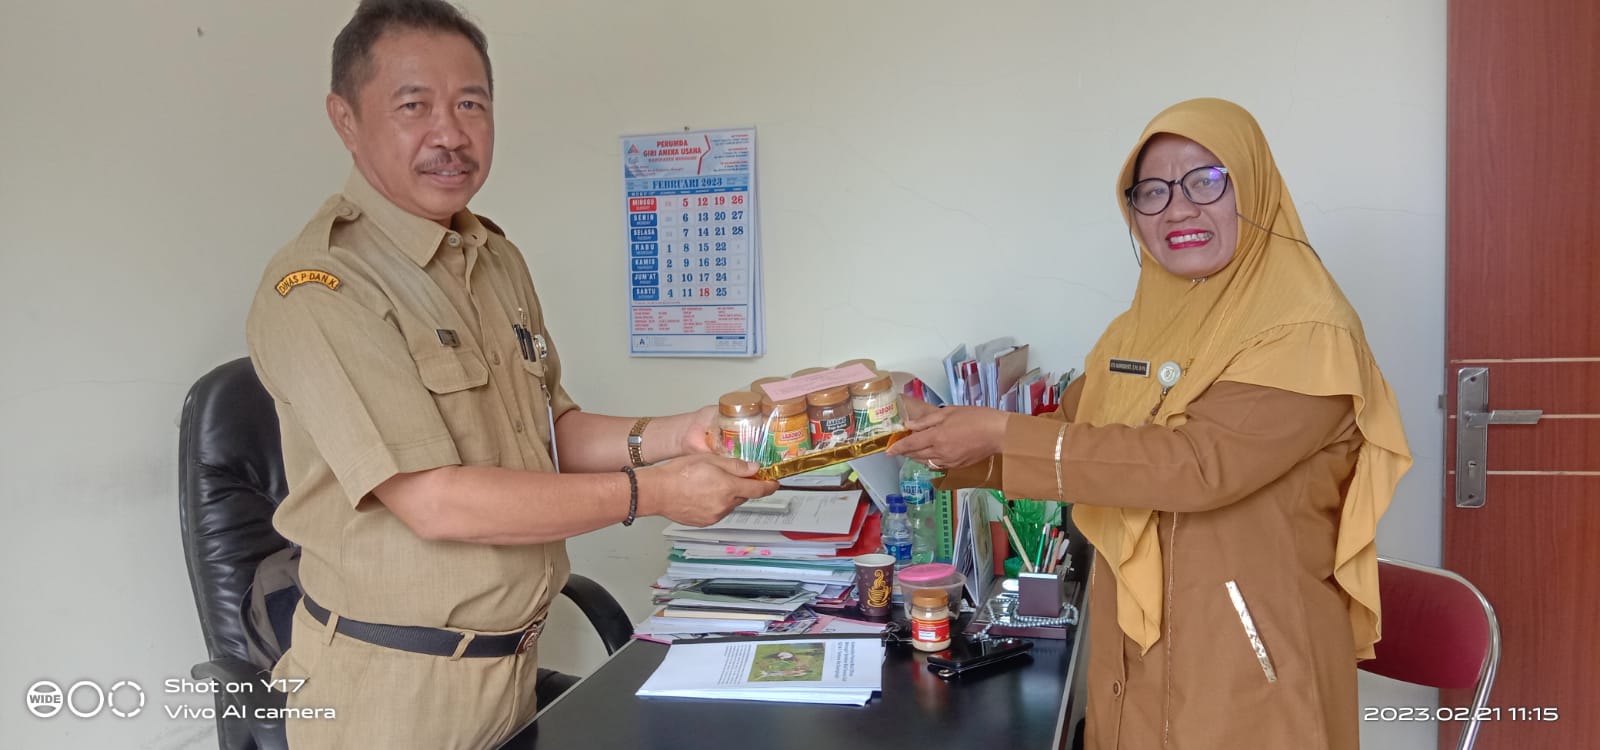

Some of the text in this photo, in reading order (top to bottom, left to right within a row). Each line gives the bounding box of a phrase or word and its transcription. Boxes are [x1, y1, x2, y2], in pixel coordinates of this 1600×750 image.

[656, 139, 688, 148] PERUMDA
[643, 149, 657, 157] GIRI
[652, 178, 699, 190] FEBRUARI
[701, 177, 723, 187] 2023
[682, 198, 689, 207] 5
[697, 197, 708, 207] 12
[714, 196, 725, 205] 19
[731, 195, 744, 205] 26
[682, 213, 689, 222] 6
[698, 212, 709, 222] 13
[714, 211, 726, 221] 20
[731, 210, 744, 220] 27
[683, 228, 689, 237] 7
[698, 228, 709, 237] 14
[714, 226, 725, 236] 21
[731, 225, 744, 235] 28
[667, 244, 672, 253] 1
[683, 243, 690, 252] 8
[698, 242, 710, 252] 15
[715, 241, 727, 251] 22
[666, 259, 673, 268] 2
[683, 258, 690, 268] 9
[699, 257, 710, 267] 16
[715, 256, 727, 267] 23
[279, 272, 337, 293] DINAS P DAN K
[666, 273, 673, 283] 3
[682, 273, 693, 282] 10
[700, 272, 710, 282] 17
[715, 272, 727, 282] 24
[667, 288, 674, 298] 4
[682, 288, 692, 297] 11
[699, 287, 710, 297] 18
[715, 287, 727, 297] 25
